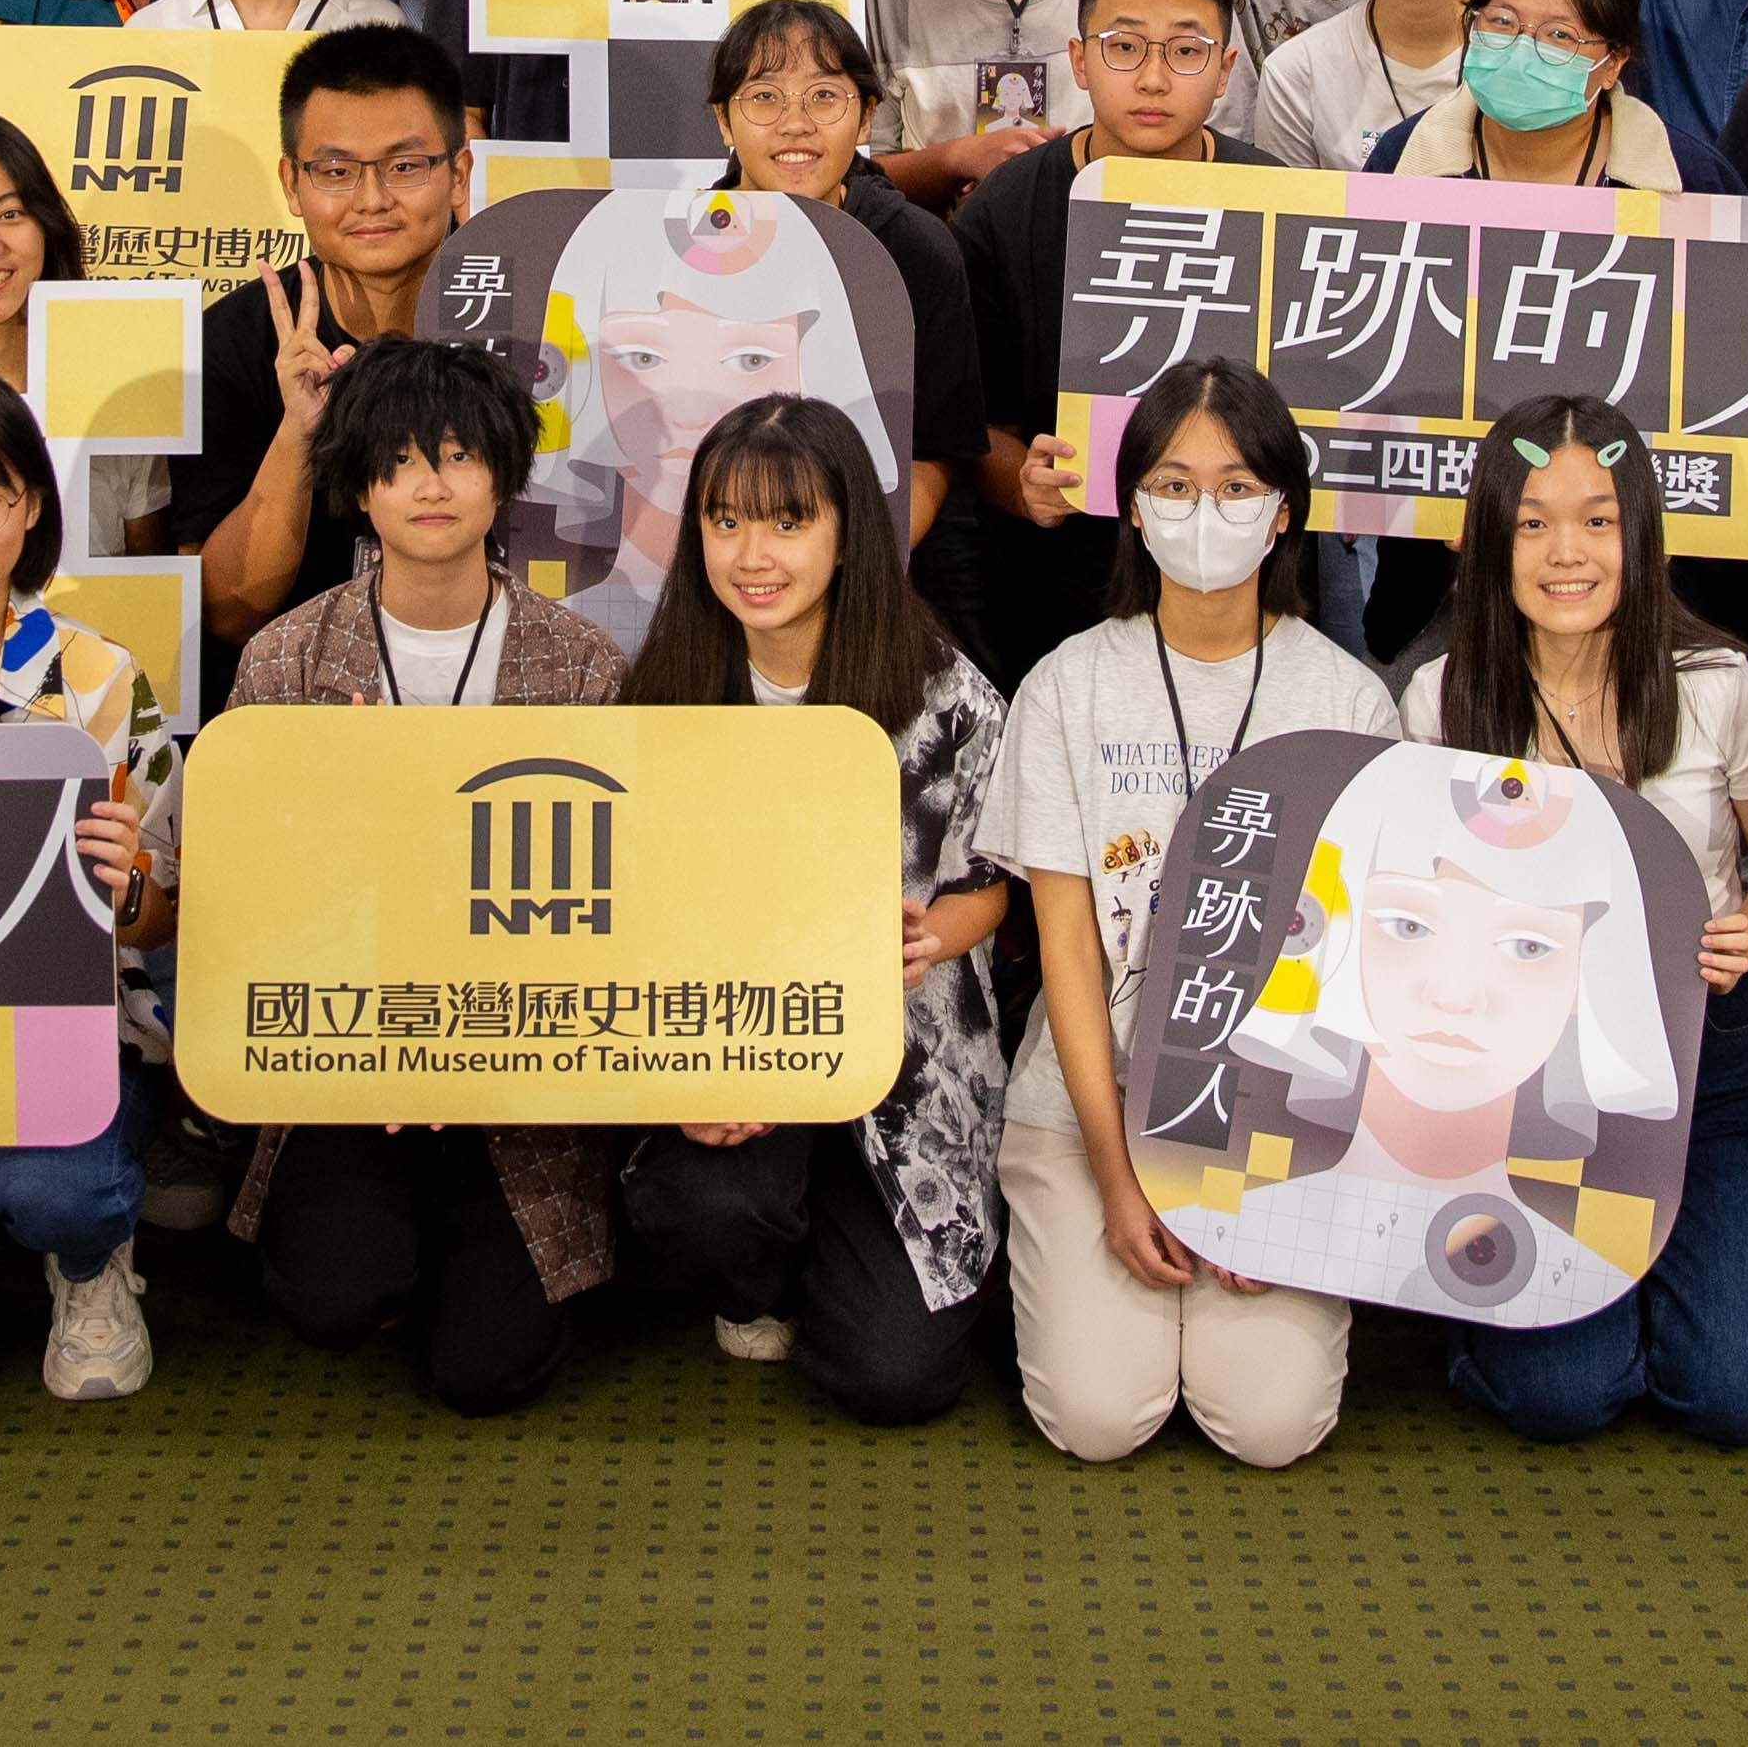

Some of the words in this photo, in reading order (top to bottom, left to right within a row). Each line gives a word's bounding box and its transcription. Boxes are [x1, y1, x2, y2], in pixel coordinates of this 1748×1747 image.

[1140, 788, 1277, 1136] 尋跡的人
[246, 980, 844, 1038] 國立臺灣歷史博物館
[244, 1044, 387, 1073] National
[397, 1046, 543, 1073] Museum
[552, 1044, 588, 1072] of
[592, 1045, 711, 1072] Taiwan
[723, 1045, 844, 1079] History
